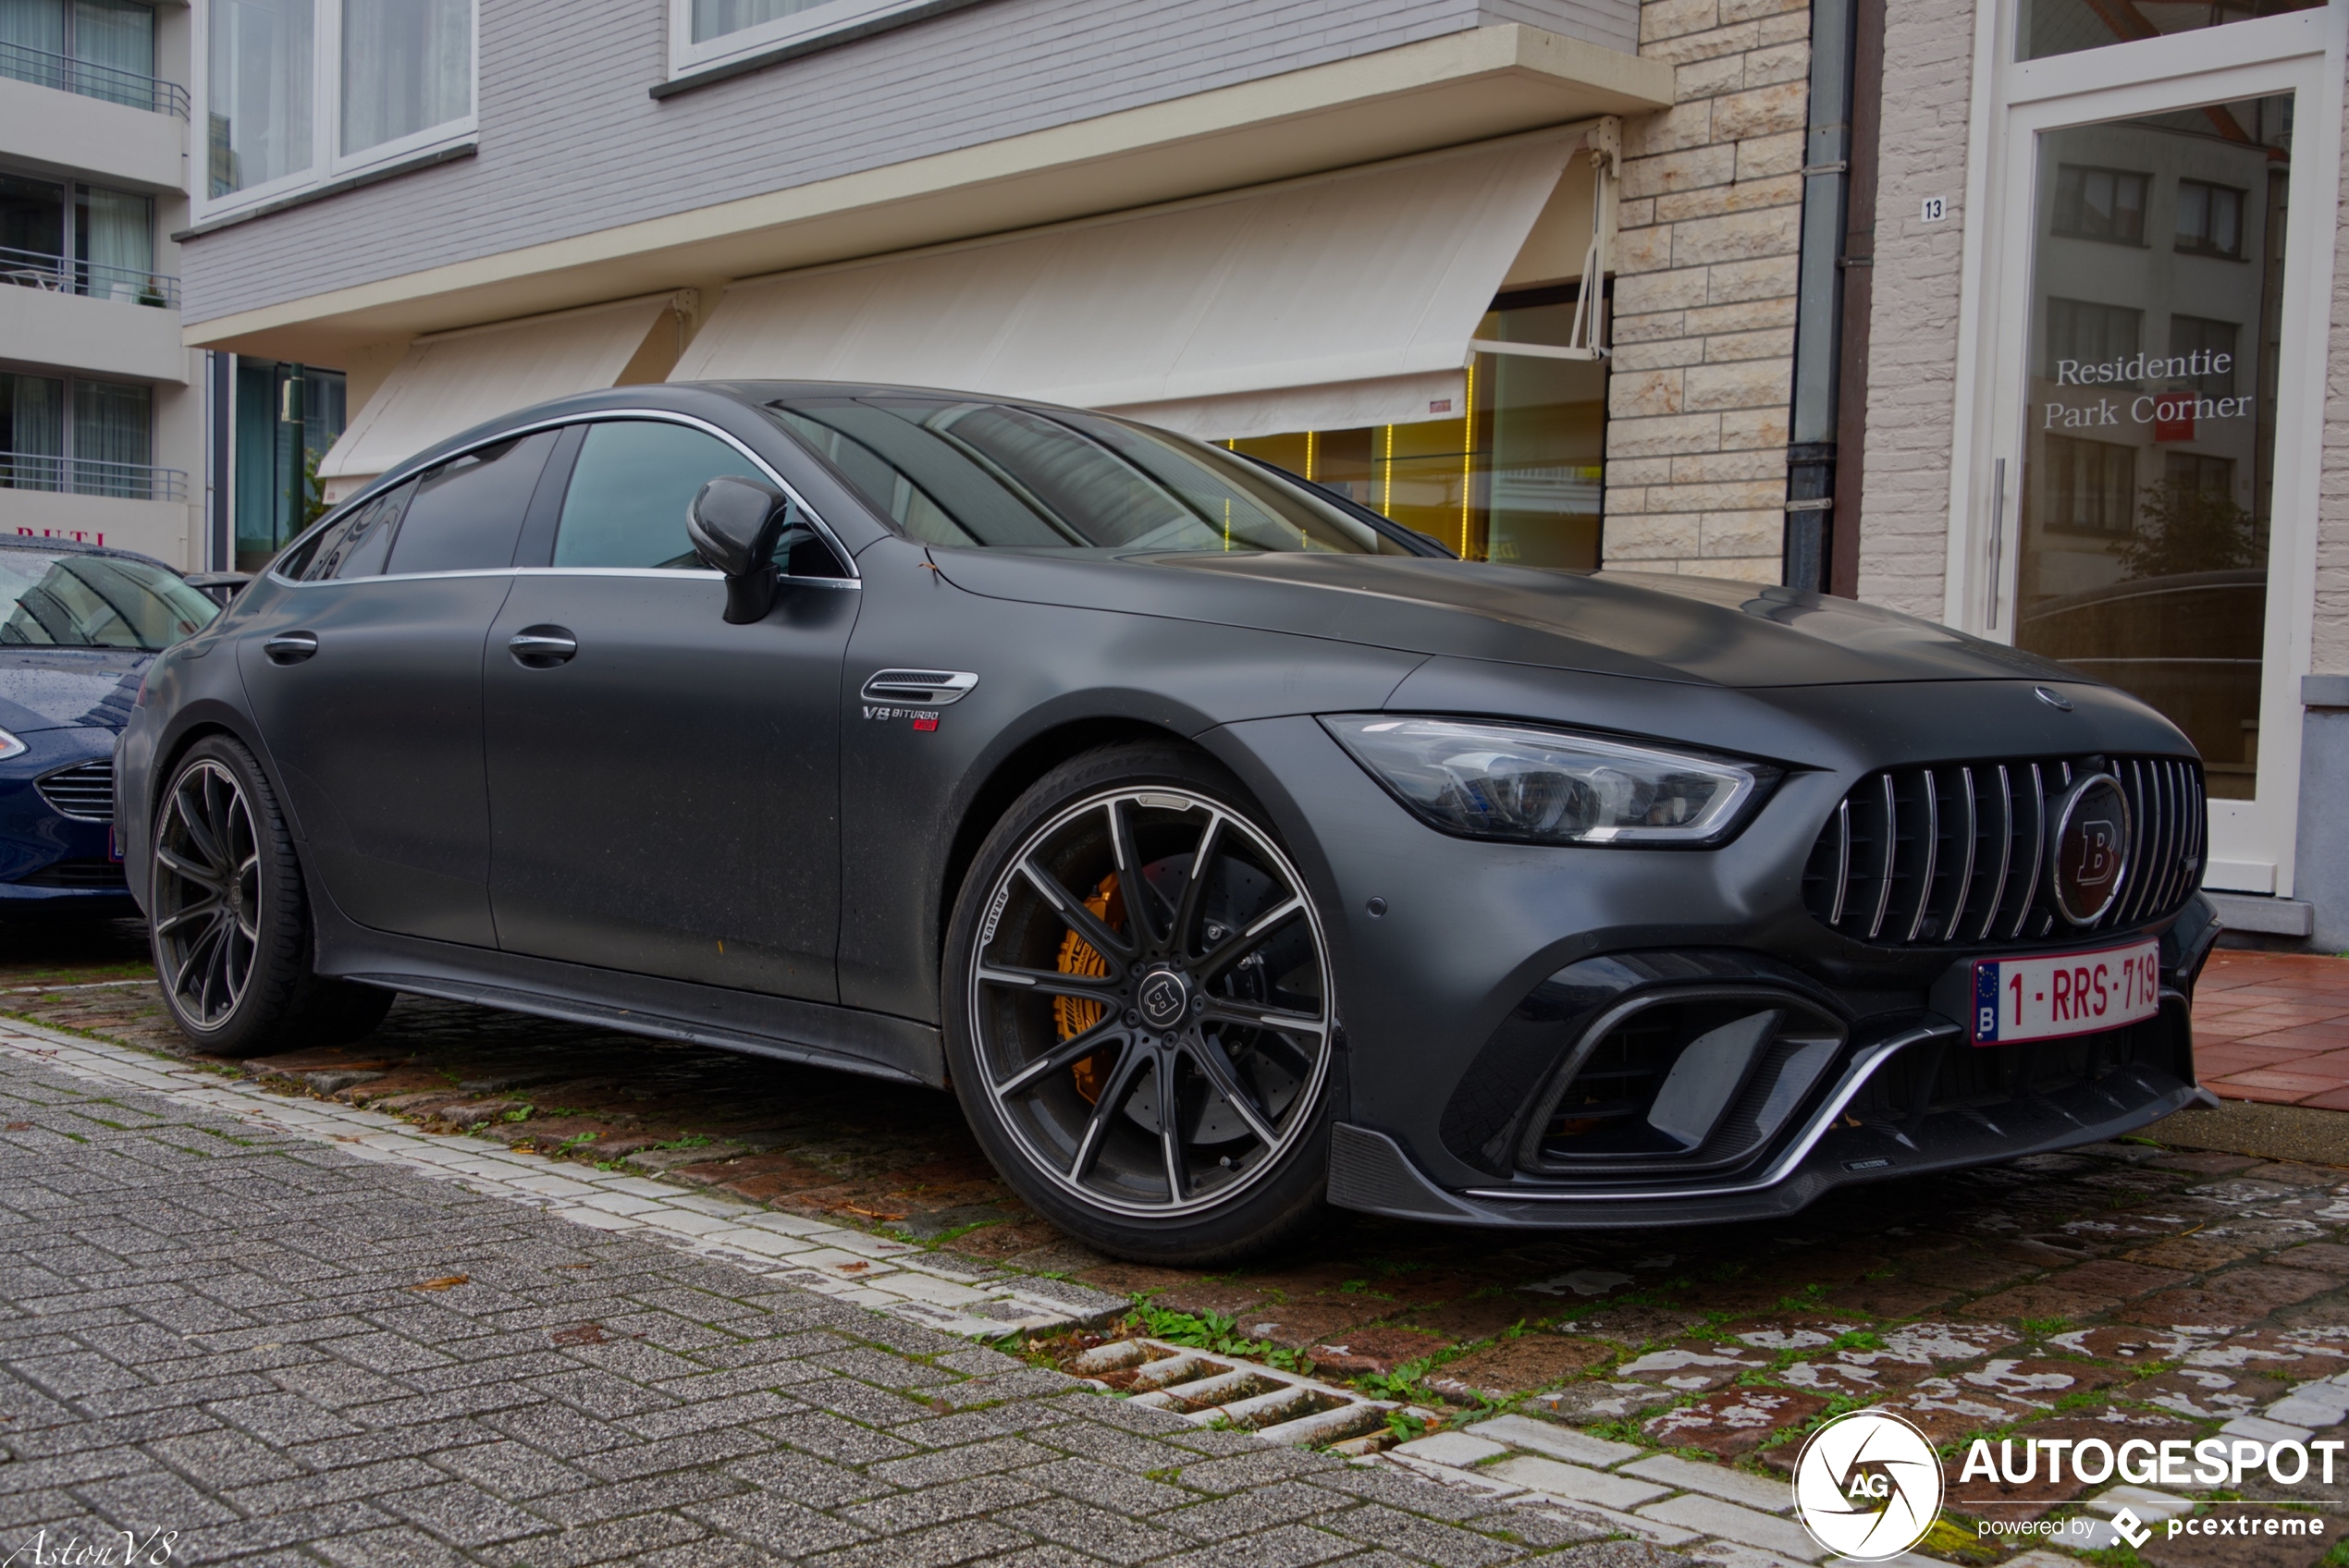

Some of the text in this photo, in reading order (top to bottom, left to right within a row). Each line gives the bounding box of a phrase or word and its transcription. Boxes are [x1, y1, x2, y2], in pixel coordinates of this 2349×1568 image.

[1925, 200, 1941, 219] 13
[2055, 349, 2232, 386] Residentie
[2043, 396, 2253, 429] Park Corner
[863, 705, 940, 721] V8 BITURBO
[2077, 819, 2117, 887] B
[983, 891, 1007, 942] BRABUS
[1144, 981, 1179, 1017] B
[2009, 952, 2156, 1026] 1-RRS-719
[1979, 1007, 1994, 1033] B
